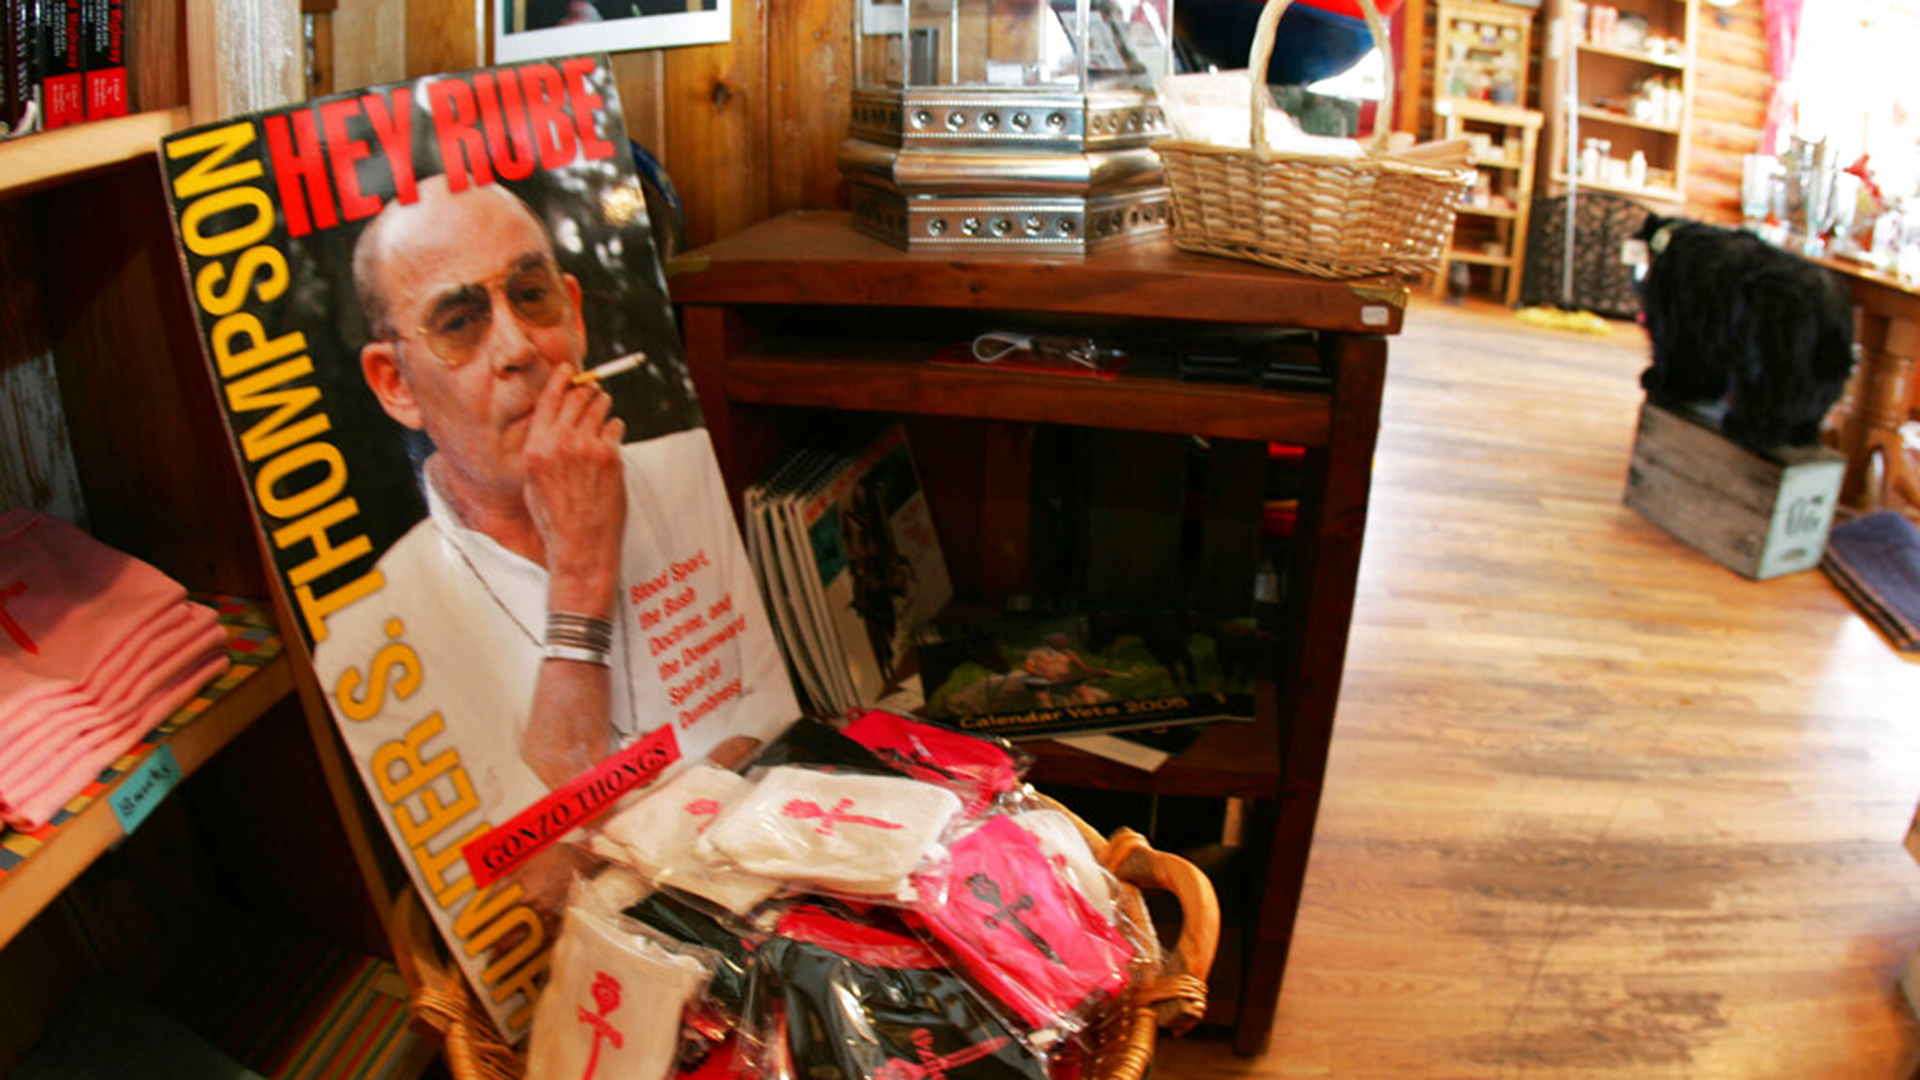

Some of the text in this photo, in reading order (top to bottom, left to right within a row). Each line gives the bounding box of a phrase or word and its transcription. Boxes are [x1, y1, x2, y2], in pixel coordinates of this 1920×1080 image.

[263, 57, 616, 239] HEY RUBE
[165, 120, 553, 1031] HUNTER S. THOMPSON
[629, 569, 670, 606] Blood
[639, 585, 697, 632] the Bush
[709, 591, 733, 621] and
[658, 611, 747, 682] the Downward
[667, 657, 722, 707] Spiral of
[958, 708, 1064, 731] Calendar
[481, 741, 669, 870] GONZO THONGS
